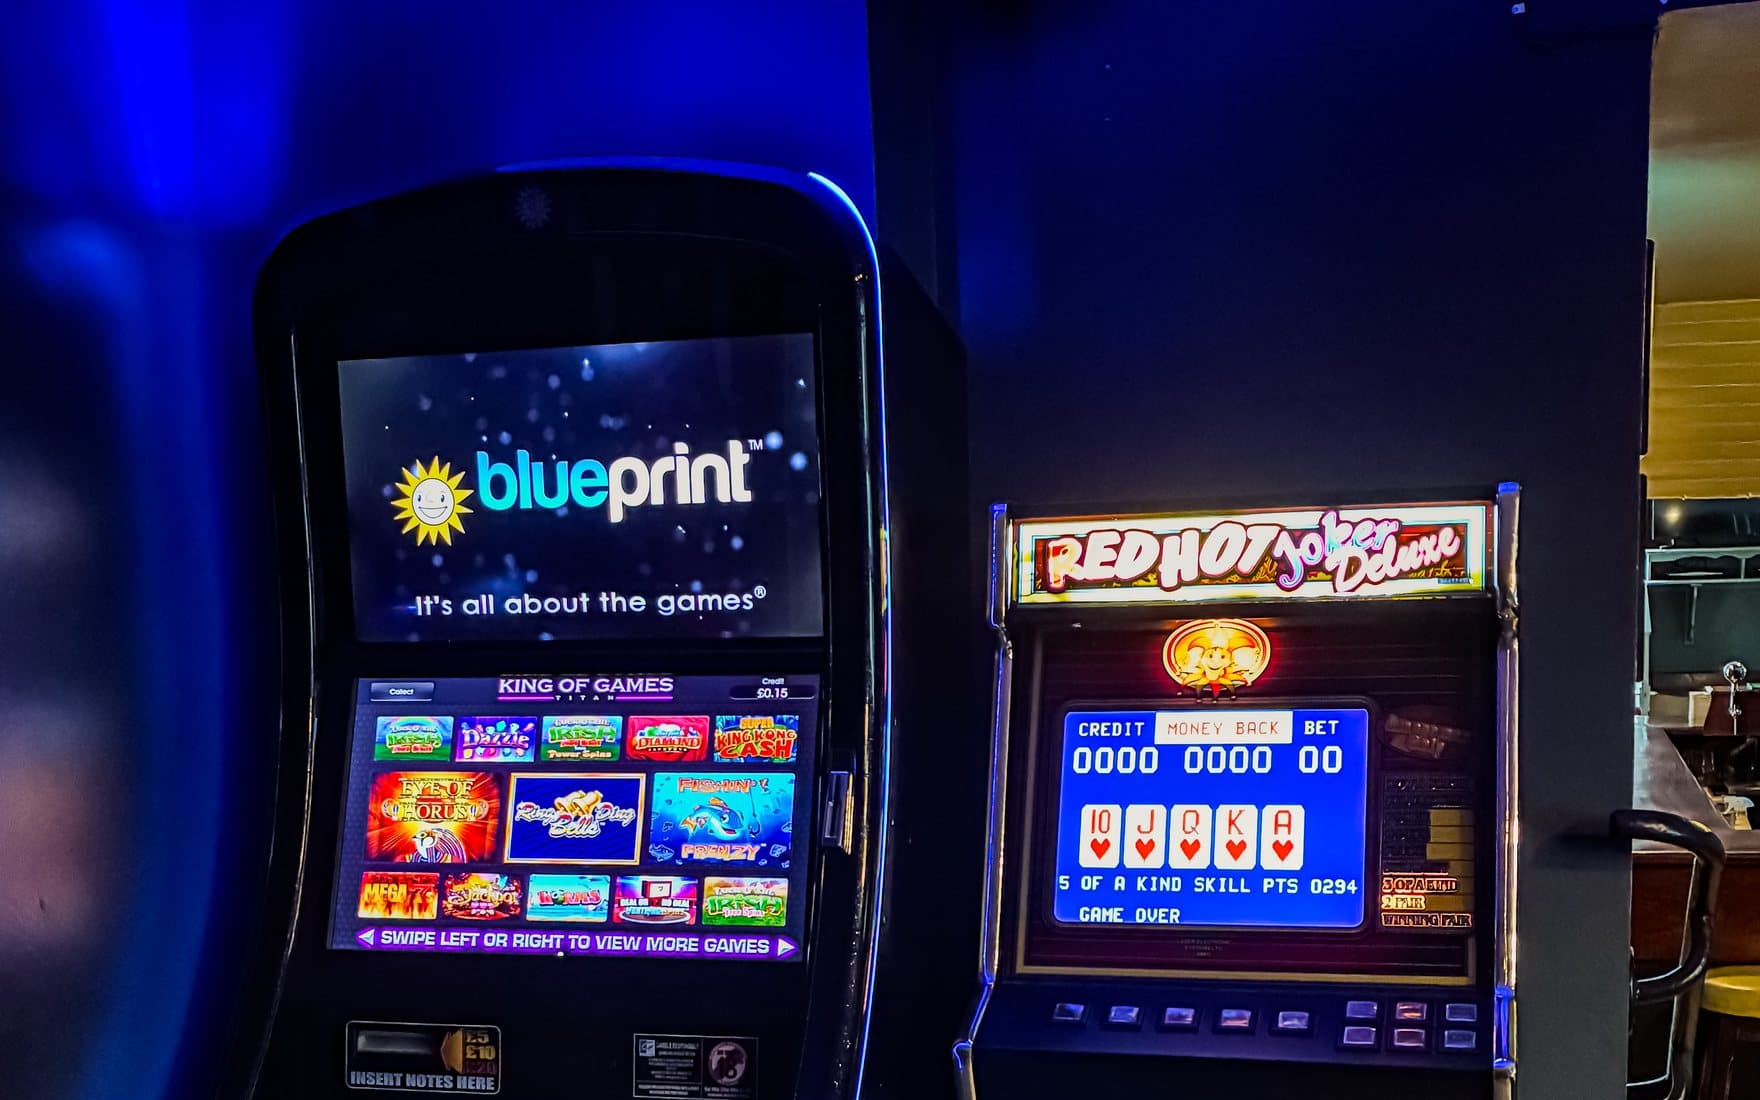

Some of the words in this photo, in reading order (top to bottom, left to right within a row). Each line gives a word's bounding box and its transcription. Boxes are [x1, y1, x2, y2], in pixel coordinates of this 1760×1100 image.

[477, 439, 752, 523] blueprint
[1048, 528, 1160, 588] RED
[1157, 519, 1282, 590] HOT
[1325, 526, 1460, 592] Deluxe
[415, 595, 453, 616] It's
[462, 594, 494, 615] all
[504, 592, 590, 614] about
[600, 591, 647, 612] the
[499, 678, 553, 693] KING
[558, 678, 590, 693] OF
[595, 677, 673, 693] GAMES
[756, 687, 788, 699] £0.15
[1079, 722, 1144, 737] CREDIT
[1167, 722, 1223, 736] MONEY
[1236, 721, 1279, 735] BACK
[1304, 720, 1340, 735] BET
[716, 731, 752, 751] KING
[753, 728, 797, 742] KONG
[720, 740, 793, 759] CASH
[1073, 746, 1159, 774] 0000
[1184, 746, 1272, 774] 0000
[1299, 745, 1342, 774] 00
[402, 781, 441, 795] EYE
[446, 780, 474, 797] OF
[402, 803, 469, 820] HORUS
[1091, 809, 1111, 834] 10
[1137, 809, 1155, 834] J
[1182, 810, 1200, 835] Q
[1228, 809, 1245, 835] K
[1274, 810, 1292, 835] A
[681, 843, 760, 860] FRENZY
[364, 883, 407, 902] MEGA
[1058, 875, 1070, 890] 5
[1080, 875, 1103, 891] OF
[1114, 875, 1126, 891] A
[1137, 876, 1182, 892] KIND
[1194, 877, 1251, 893] SKILL
[1263, 878, 1298, 894] PTS
[1310, 878, 1358, 894] 0294
[1079, 906, 1124, 923] GAME
[1136, 907, 1181, 923] OVER
[1441, 914, 1471, 927] PAIR
[381, 931, 436, 945] SWIPE
[440, 932, 480, 947] LEFT
[484, 933, 507, 948] OR
[512, 933, 564, 949] RIGHT
[568, 935, 591, 949] TO
[595, 935, 642, 951] VIEW
[646, 937, 699, 952] MORE
[704, 939, 770, 954] GAMES
[350, 1072, 402, 1087] INSERT
[406, 1074, 454, 1089] NOTES
[457, 1076, 495, 1091] HERE
